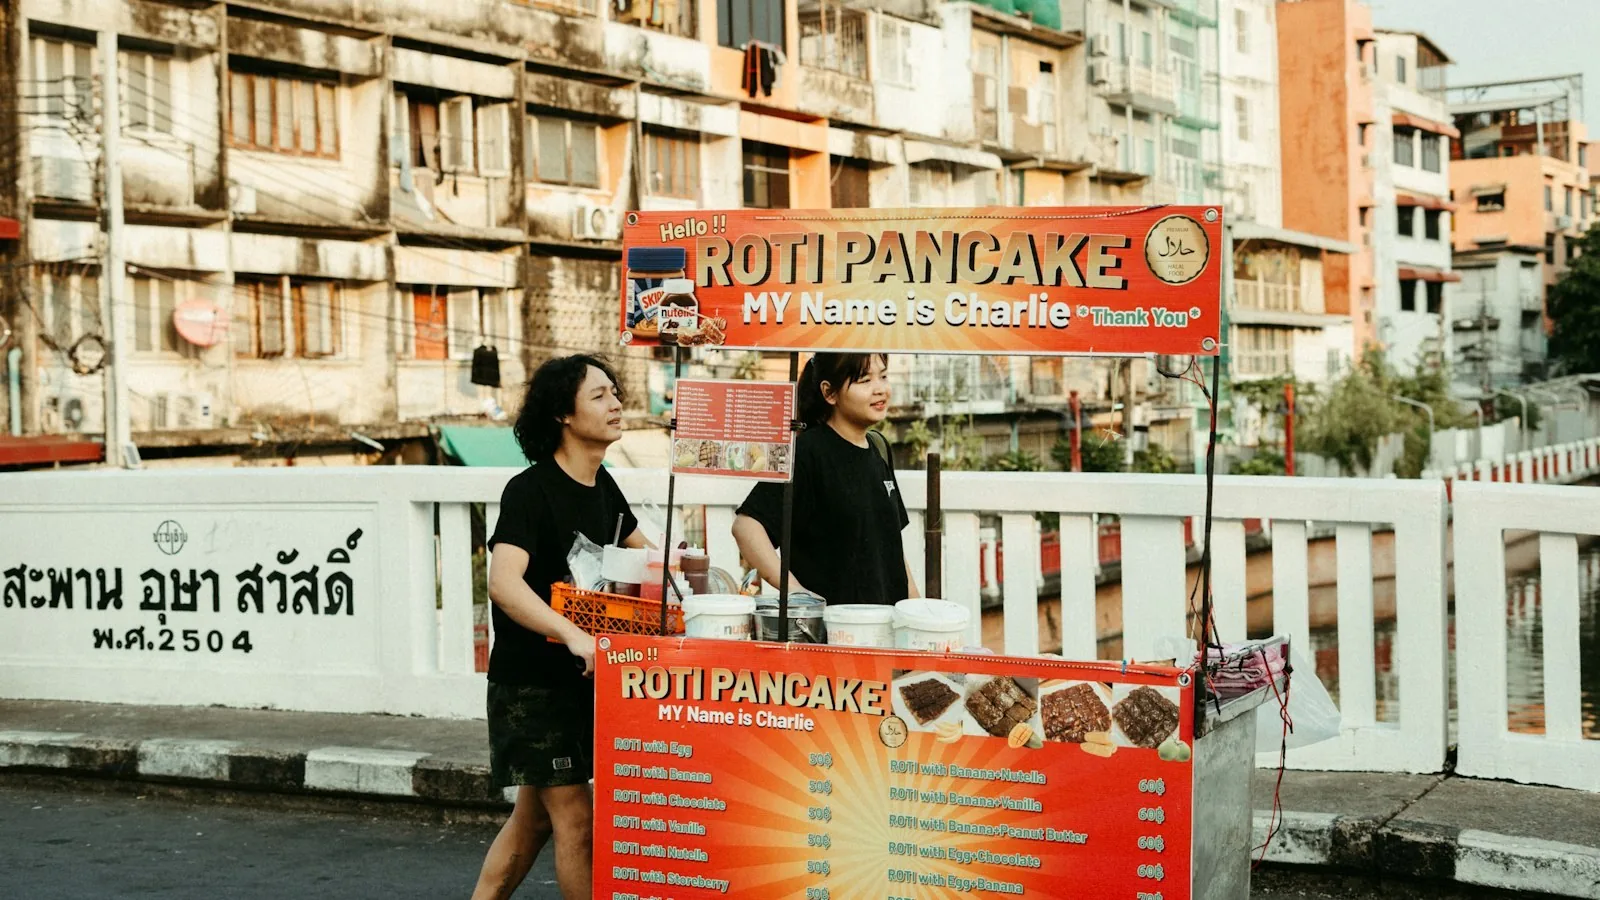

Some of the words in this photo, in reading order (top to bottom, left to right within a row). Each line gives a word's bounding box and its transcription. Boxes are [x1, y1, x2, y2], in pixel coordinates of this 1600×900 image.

[660, 217, 707, 242] Hello
[713, 214, 727, 233] !!
[1158, 236, 1195, 257] حلال
[696, 233, 824, 287] ROTI
[836, 231, 1131, 290] PANCAKE
[743, 291, 792, 325] MY
[800, 292, 897, 326] Name
[907, 290, 934, 326] is
[945, 291, 1071, 328] Charlie
[3, 563, 123, 610] สะพาน
[139, 567, 220, 626] อุษา
[235, 527, 364, 616] สวัสดิ์
[607, 649, 643, 665] Hello
[647, 648, 658, 661] !!
[621, 665, 704, 700] ROTI
[711, 667, 886, 716] PANCAKE
[658, 704, 683, 722] MY
[687, 706, 734, 726] Name
[739, 708, 752, 727] is
[756, 712, 815, 732] Charlie
[614, 738, 641, 752] ROTI
[643, 740, 668, 755] with
[670, 742, 693, 758] Egg
[614, 764, 640, 777] ROTI
[643, 766, 668, 781] with
[670, 768, 712, 784] Banana
[890, 760, 918, 774] ROTI
[921, 762, 947, 777] with
[949, 765, 1047, 785] Banana+Nutella
[613, 790, 640, 804] ROTI
[642, 792, 667, 807] with
[669, 794, 726, 811] Chocolate
[889, 787, 918, 802] ROTI
[920, 790, 946, 804] with
[949, 792, 1042, 812] Banana+Vanilla
[613, 816, 640, 830] ROTI
[642, 818, 667, 833] with
[669, 820, 706, 835] Vanilla
[889, 815, 917, 829] ROTI
[919, 817, 945, 832] with
[949, 820, 1044, 841] Banana+Peanut
[1046, 826, 1087, 845] Butter
[613, 841, 640, 855] ROTI
[641, 844, 666, 858] with
[668, 846, 708, 862] Nutella
[888, 842, 917, 857] ROTI
[919, 844, 945, 859] with
[948, 847, 1041, 868] Egg+Chocolate
[613, 866, 639, 881] ROTI
[641, 870, 665, 884] with
[667, 872, 729, 893] Storeberry
[888, 869, 917, 884] ROTI
[918, 871, 945, 886] with
[947, 874, 1023, 895] Egg+Banana
